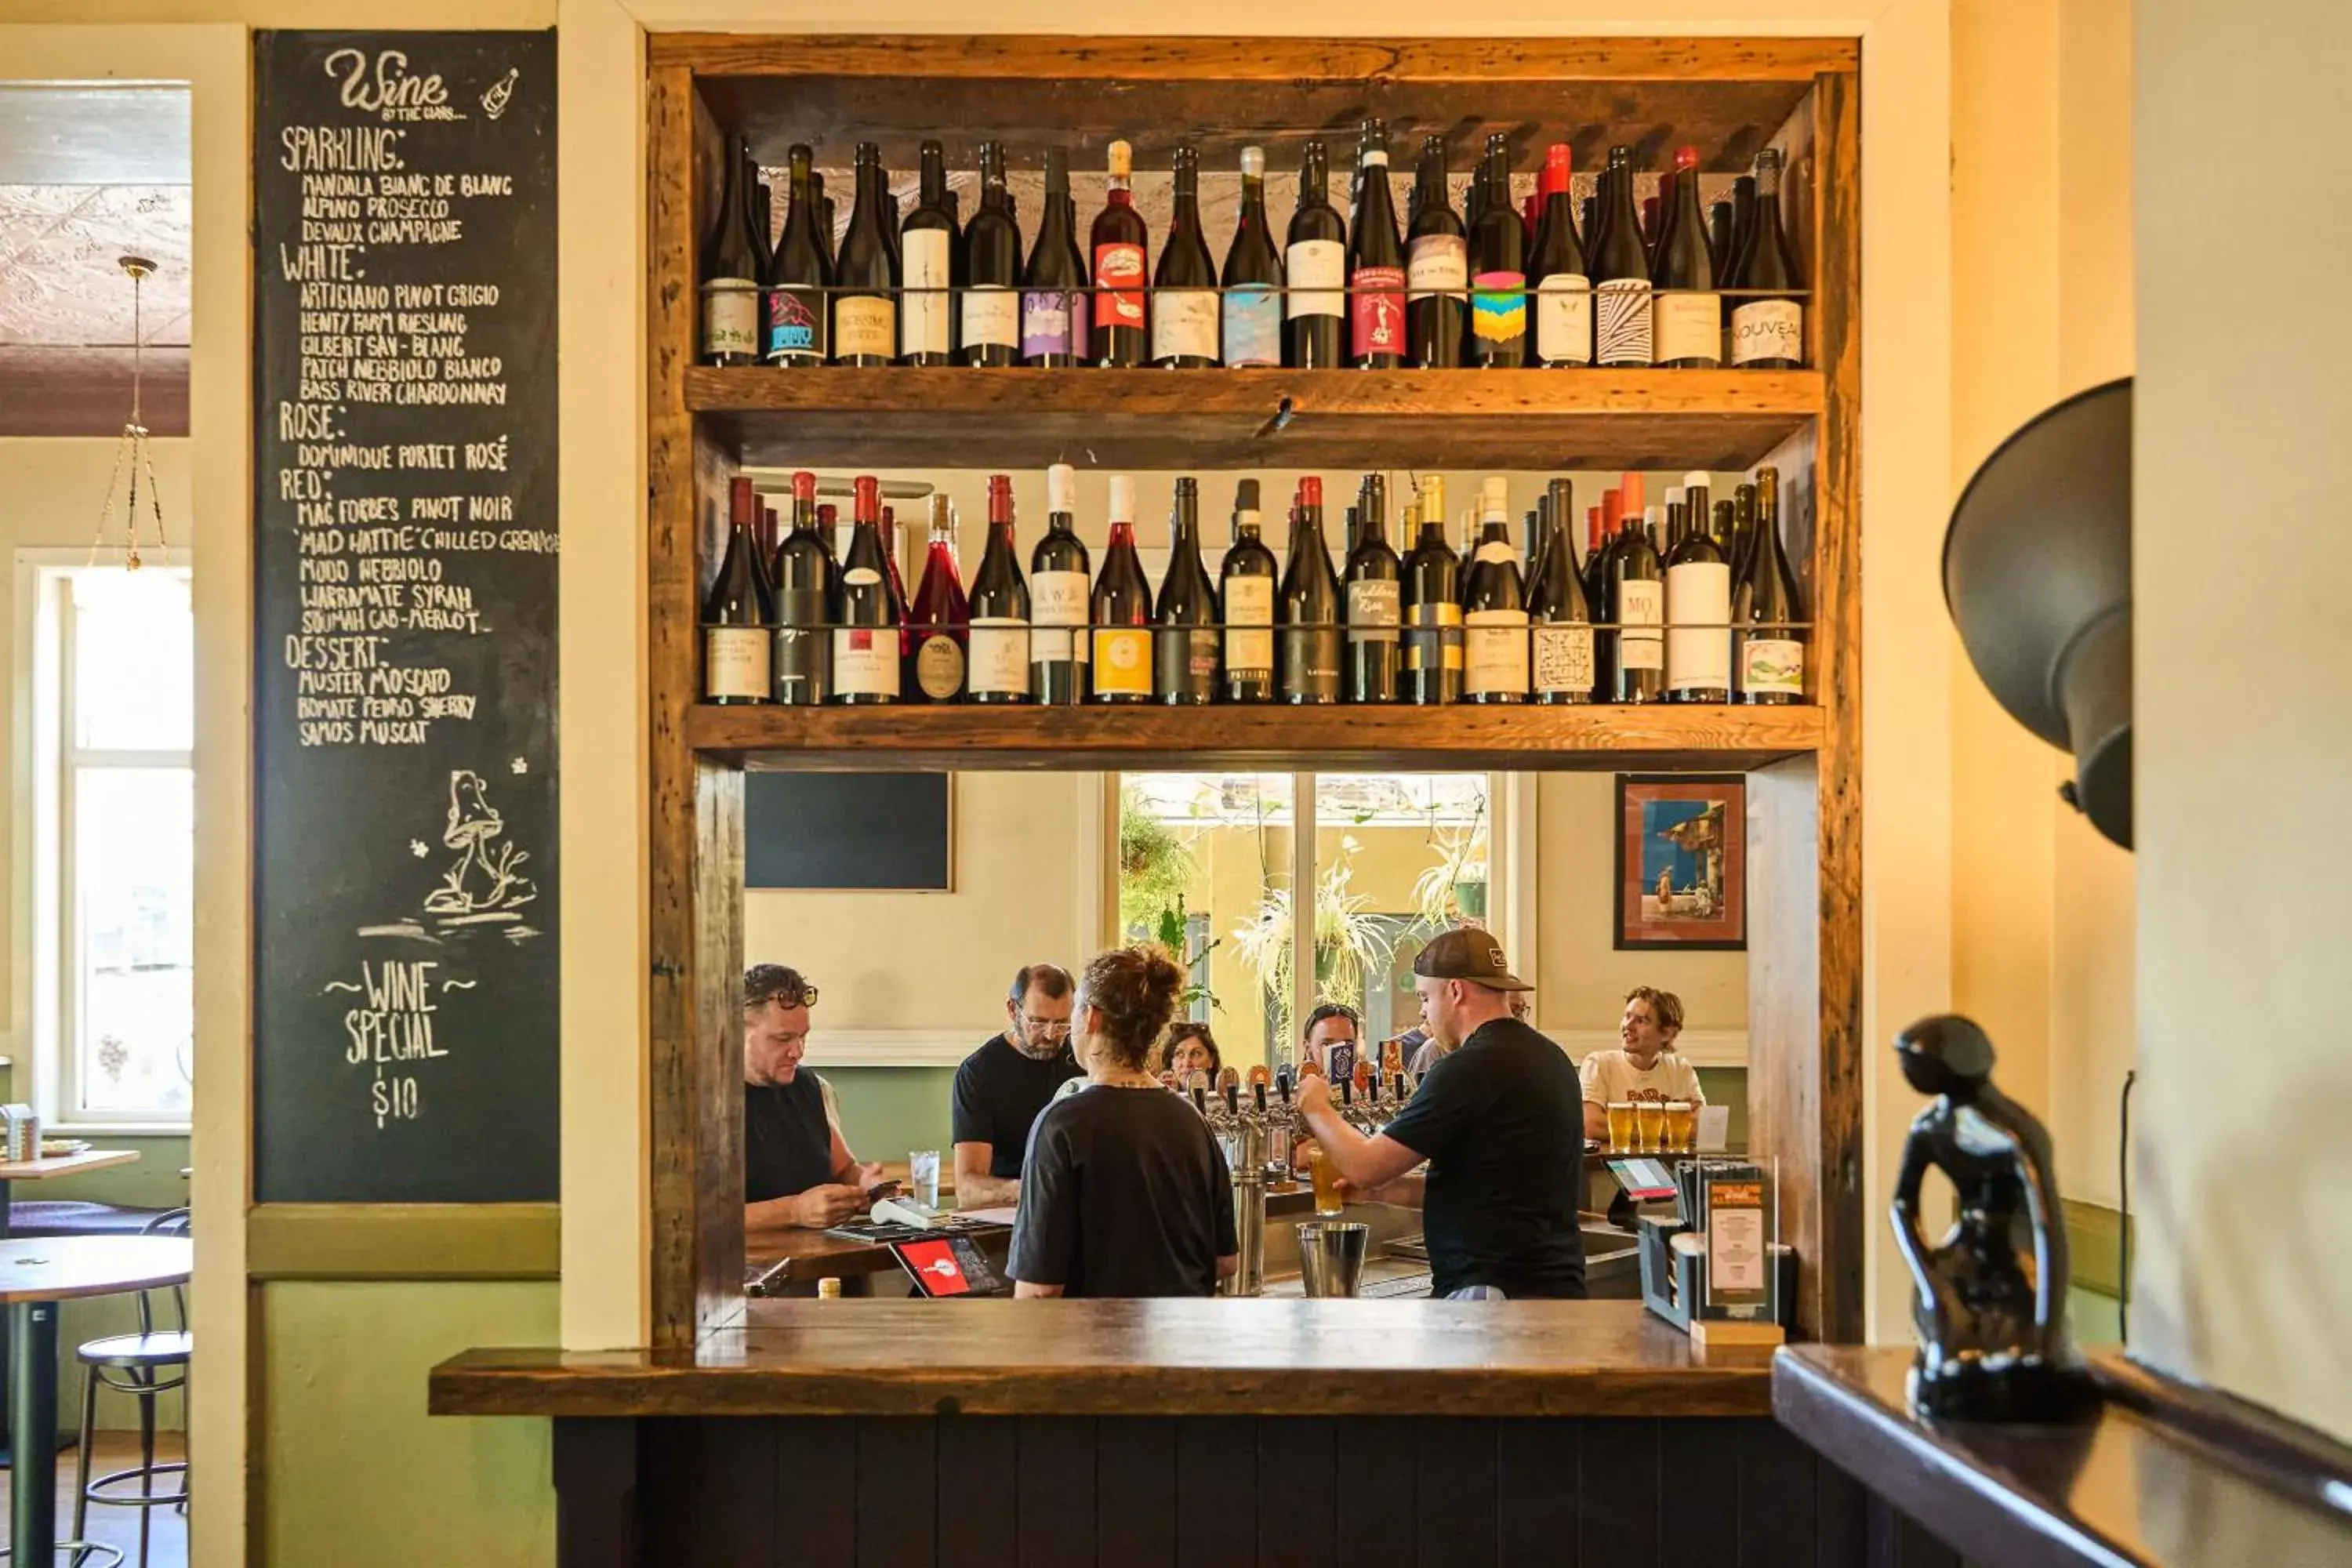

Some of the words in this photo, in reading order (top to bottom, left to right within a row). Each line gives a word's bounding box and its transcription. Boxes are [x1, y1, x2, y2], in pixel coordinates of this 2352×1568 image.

[325, 49, 448, 111] Wine
[281, 126, 407, 171] SPARKLING:
[435, 176, 455, 196] DE
[303, 196, 360, 219] ALPINO
[367, 197, 449, 219] PROSECCO
[303, 220, 364, 242] DEVAUX
[368, 220, 463, 244] CHAMPAGNE
[280, 242, 365, 281] WHITE:
[394, 284, 444, 310] PINOT
[447, 285, 499, 307] GRIGIO
[301, 312, 350, 334] HENTY
[353, 312, 394, 334] FARM
[398, 312, 468, 335] RIESLING
[301, 335, 364, 358] GILBERT
[301, 358, 349, 379] PATCH
[354, 358, 437, 382] NEBBIOLO
[445, 357, 502, 380] BIANCO
[300, 379, 340, 401] BASS
[346, 380, 392, 403] RIVER
[395, 382, 506, 405] CHARDONNAY
[280, 401, 347, 441] ROSE:
[299, 443, 393, 469] DOMINIQUE
[398, 444, 456, 469] PORTET
[466, 434, 508, 471] ROSÉ
[280, 470, 332, 500] RED:
[339, 497, 401, 524] FORBES
[412, 496, 464, 521] PINOT
[470, 495, 512, 521] NOIR
[421, 528, 496, 550] CHILLED
[358, 557, 442, 583] NEBBIOLO
[412, 584, 472, 612] SYRAH
[302, 608, 365, 634] SOUMAH
[285, 634, 390, 670] DESSERT:
[299, 670, 365, 695] MUSTER
[370, 668, 451, 696] MOSCATO
[363, 696, 414, 719] PEDRO
[419, 695, 477, 720] SHERRY
[299, 721, 354, 746] SAMOS
[359, 720, 430, 745] MUSCAT
[363, 960, 438, 1012] WINE
[346, 1009, 449, 1064] SPECIAL
[372, 1065, 419, 1129] $10
